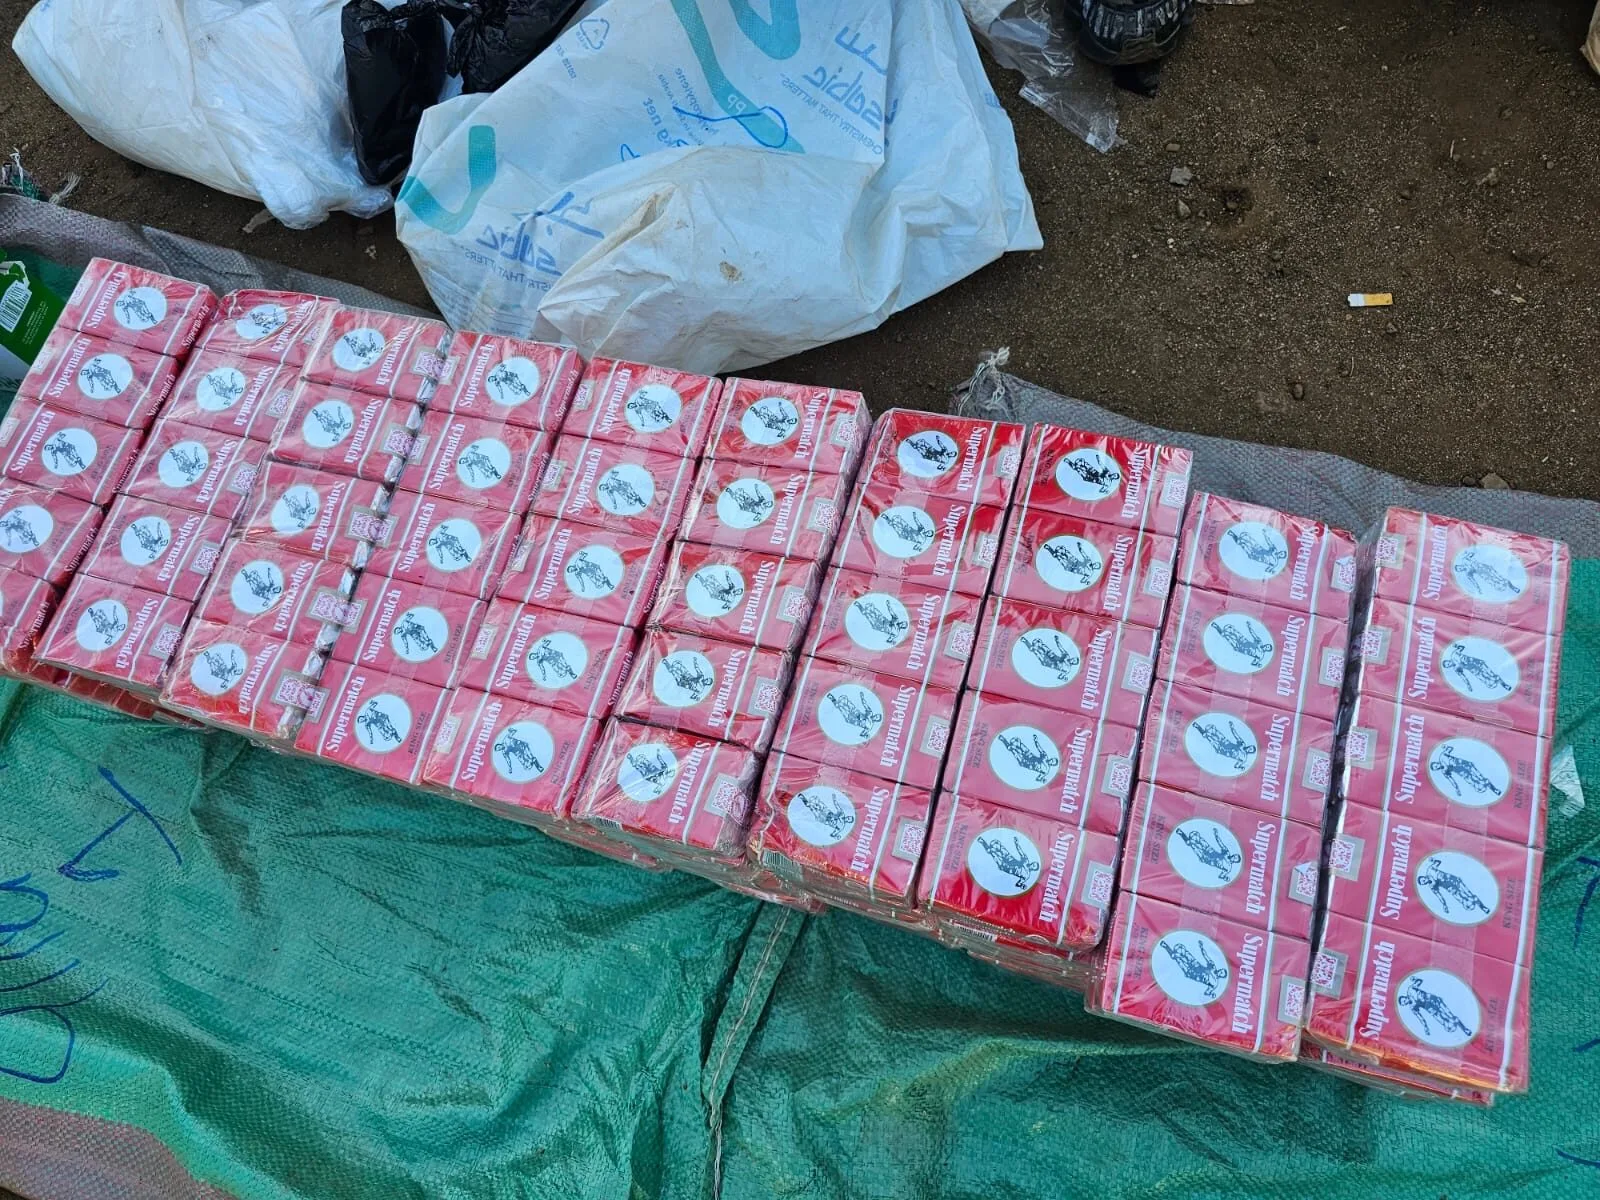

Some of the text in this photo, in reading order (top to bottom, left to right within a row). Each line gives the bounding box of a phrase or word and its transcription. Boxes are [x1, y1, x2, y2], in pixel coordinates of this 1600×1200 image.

[87, 269, 129, 329] Supermatch
[49, 338, 92, 398] Supermatch
[234, 365, 273, 426] Supermatch
[459, 343, 496, 407] Supermatch
[599, 368, 631, 434] Supermatch
[10, 411, 56, 475] Supermatch
[343, 398, 383, 464] Supermatch
[429, 423, 466, 490] Supermatch
[794, 391, 827, 460] Supermatch
[957, 425, 987, 492] Supermatch
[196, 439, 237, 504] Supermatch
[567, 448, 602, 515] Supermatch
[1122, 448, 1149, 518] Supermatch
[311, 480, 345, 551] Supermatch
[398, 502, 436, 572] Supermatch
[770, 473, 805, 545] Supermatch
[932, 504, 965, 577] Supermatch
[158, 515, 200, 582] Supermatch
[534, 528, 573, 600] Supermatch
[1103, 534, 1133, 611] Supermatch
[1289, 525, 1320, 601] Supermatch
[1422, 525, 1448, 600] Supermatch
[273, 560, 314, 632] Supermatch
[363, 588, 402, 662] Supermatch
[738, 560, 776, 635] Supermatch
[906, 590, 941, 671] Supermatch
[116, 598, 159, 669] Supermatch
[496, 614, 537, 689] Supermatch
[1080, 627, 1112, 710] Supermatch
[1277, 614, 1306, 696] Supermatch
[1408, 616, 1437, 700] Supermatch
[239, 642, 278, 714] Supermatch
[326, 676, 366, 752] Supermatch
[708, 649, 746, 727] Supermatch
[461, 702, 503, 782] Supermatch
[880, 684, 917, 767] Supermatch
[1259, 713, 1290, 802] Supermatch
[1394, 713, 1426, 805] Supermatch
[668, 740, 711, 824] Supermatch
[1060, 727, 1094, 814] Supermatch
[851, 785, 889, 872] Supermatch
[1038, 831, 1076, 922] Supermatch
[1245, 821, 1276, 915] Supermatch
[1379, 824, 1413, 920] Supermatch
[1231, 932, 1264, 1034] Supermatch
[1359, 941, 1396, 1041] Supermatch
